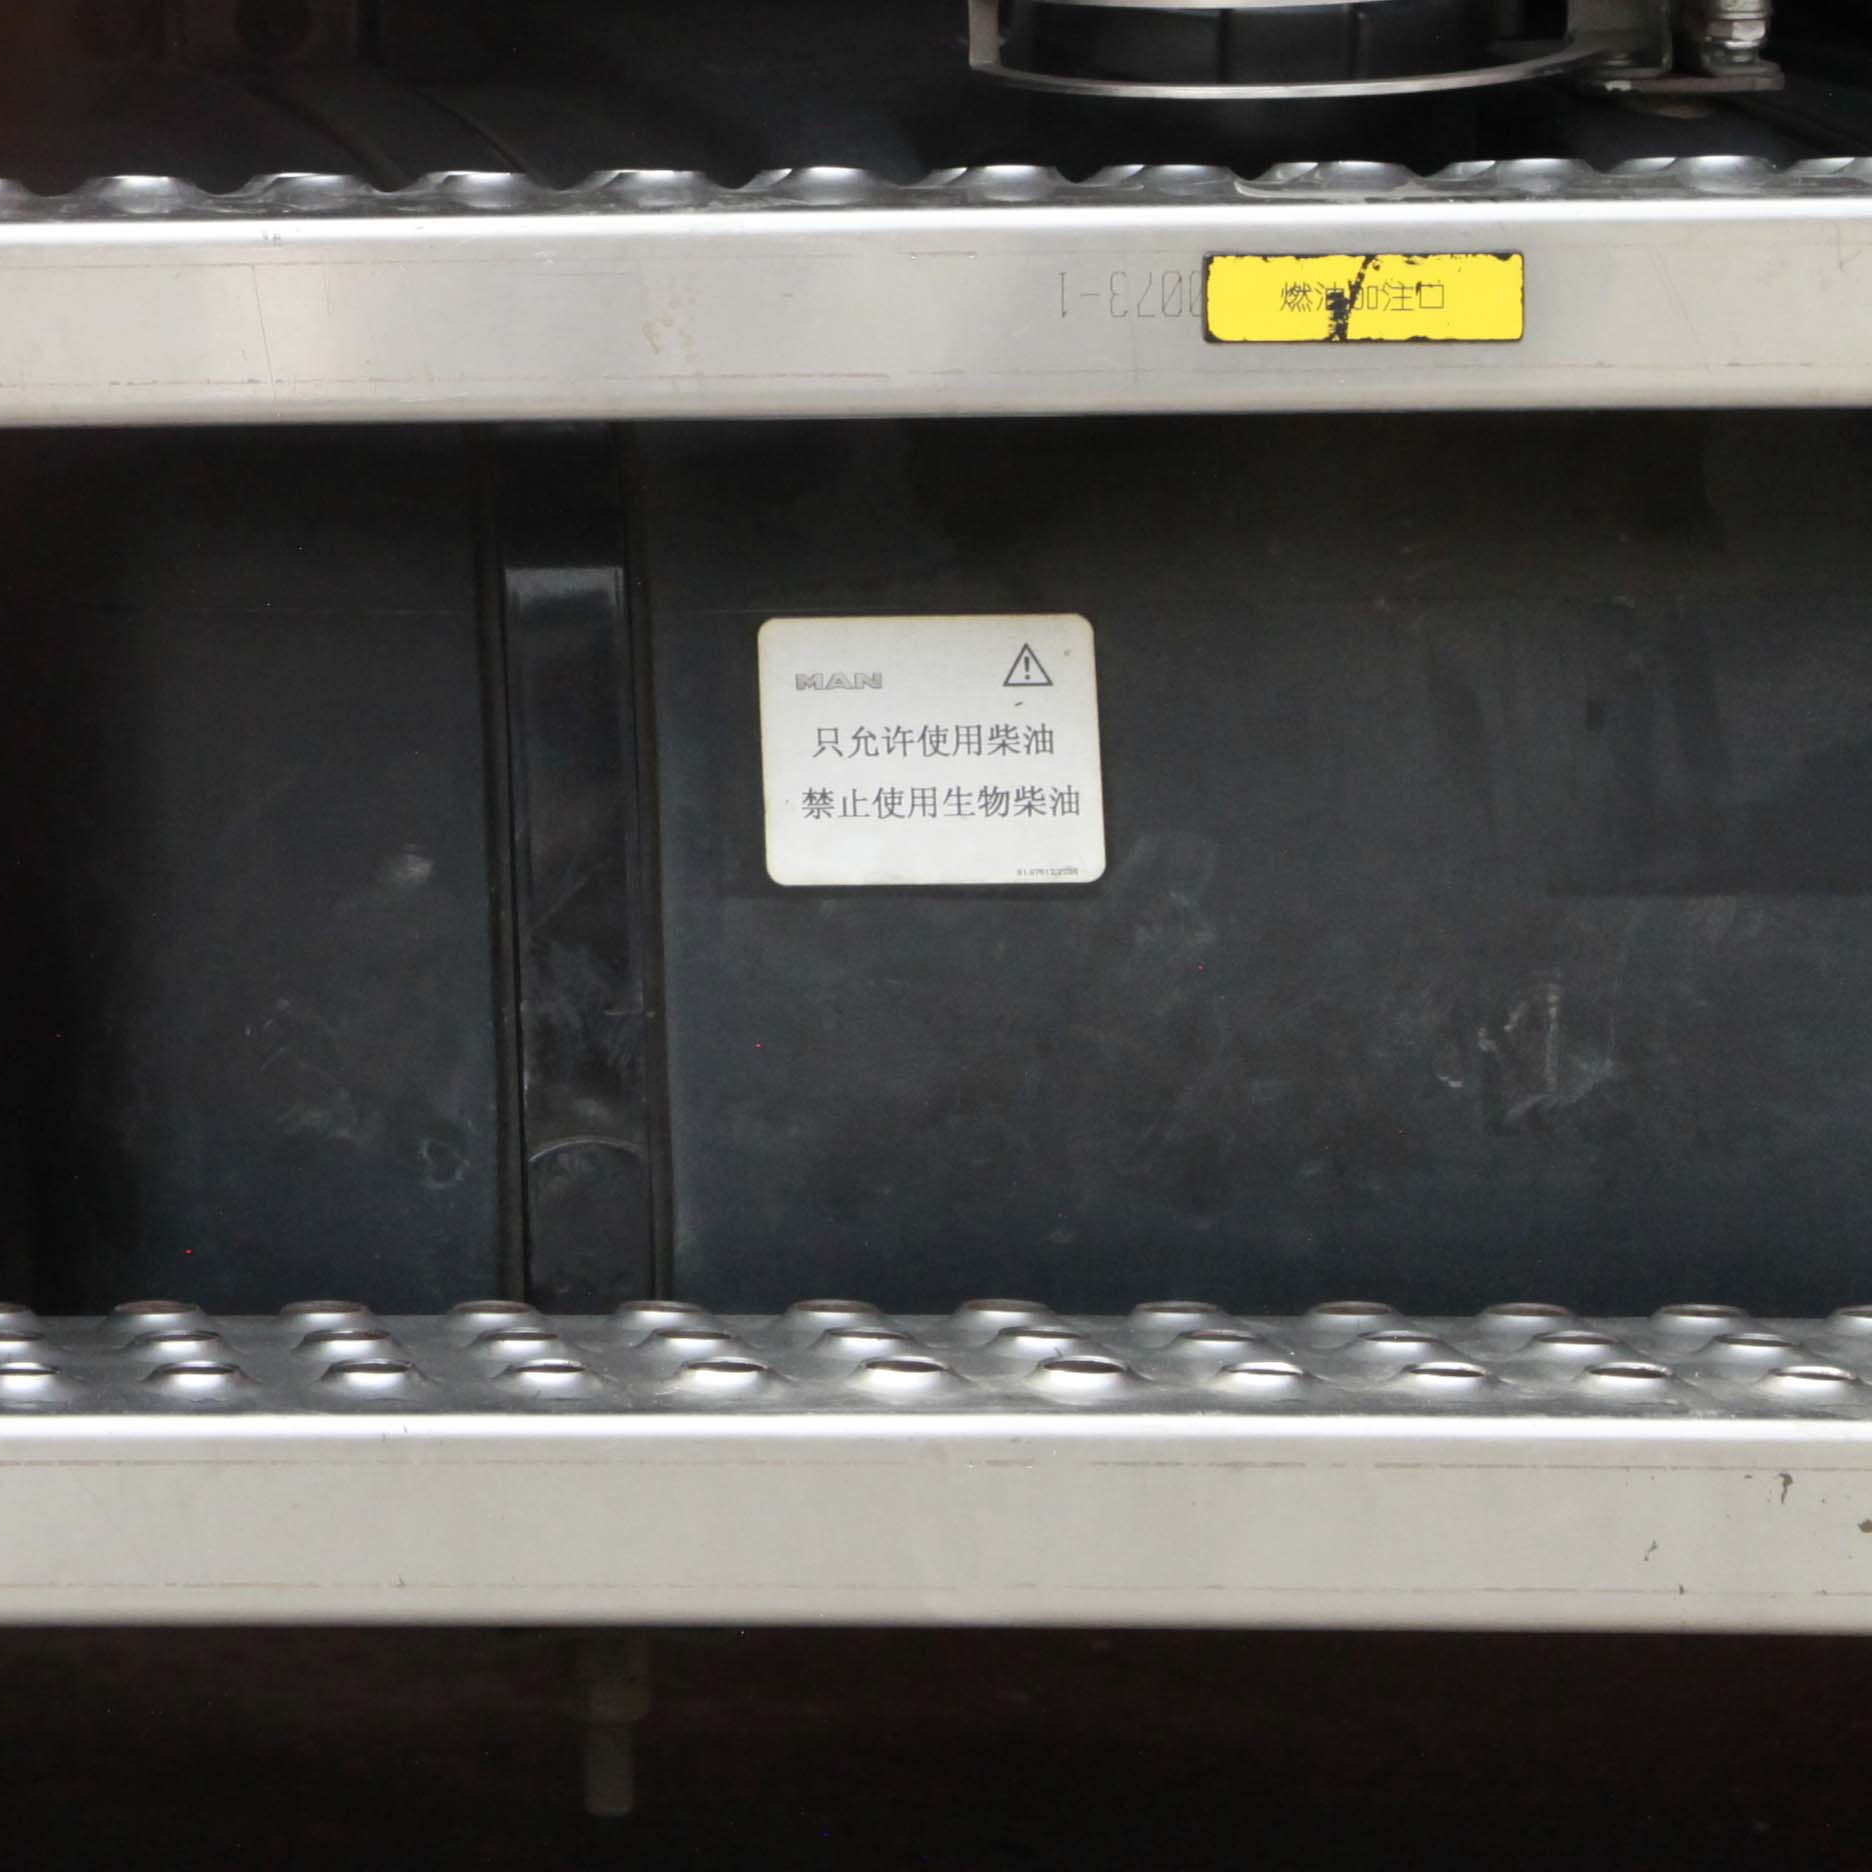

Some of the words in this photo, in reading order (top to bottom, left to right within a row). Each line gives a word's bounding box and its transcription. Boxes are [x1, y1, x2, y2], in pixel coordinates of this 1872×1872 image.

[795, 672, 883, 690] MAN
[812, 723, 1055, 759] 只允许使用柴油
[802, 784, 1081, 820] 禁止使用生物柴油
